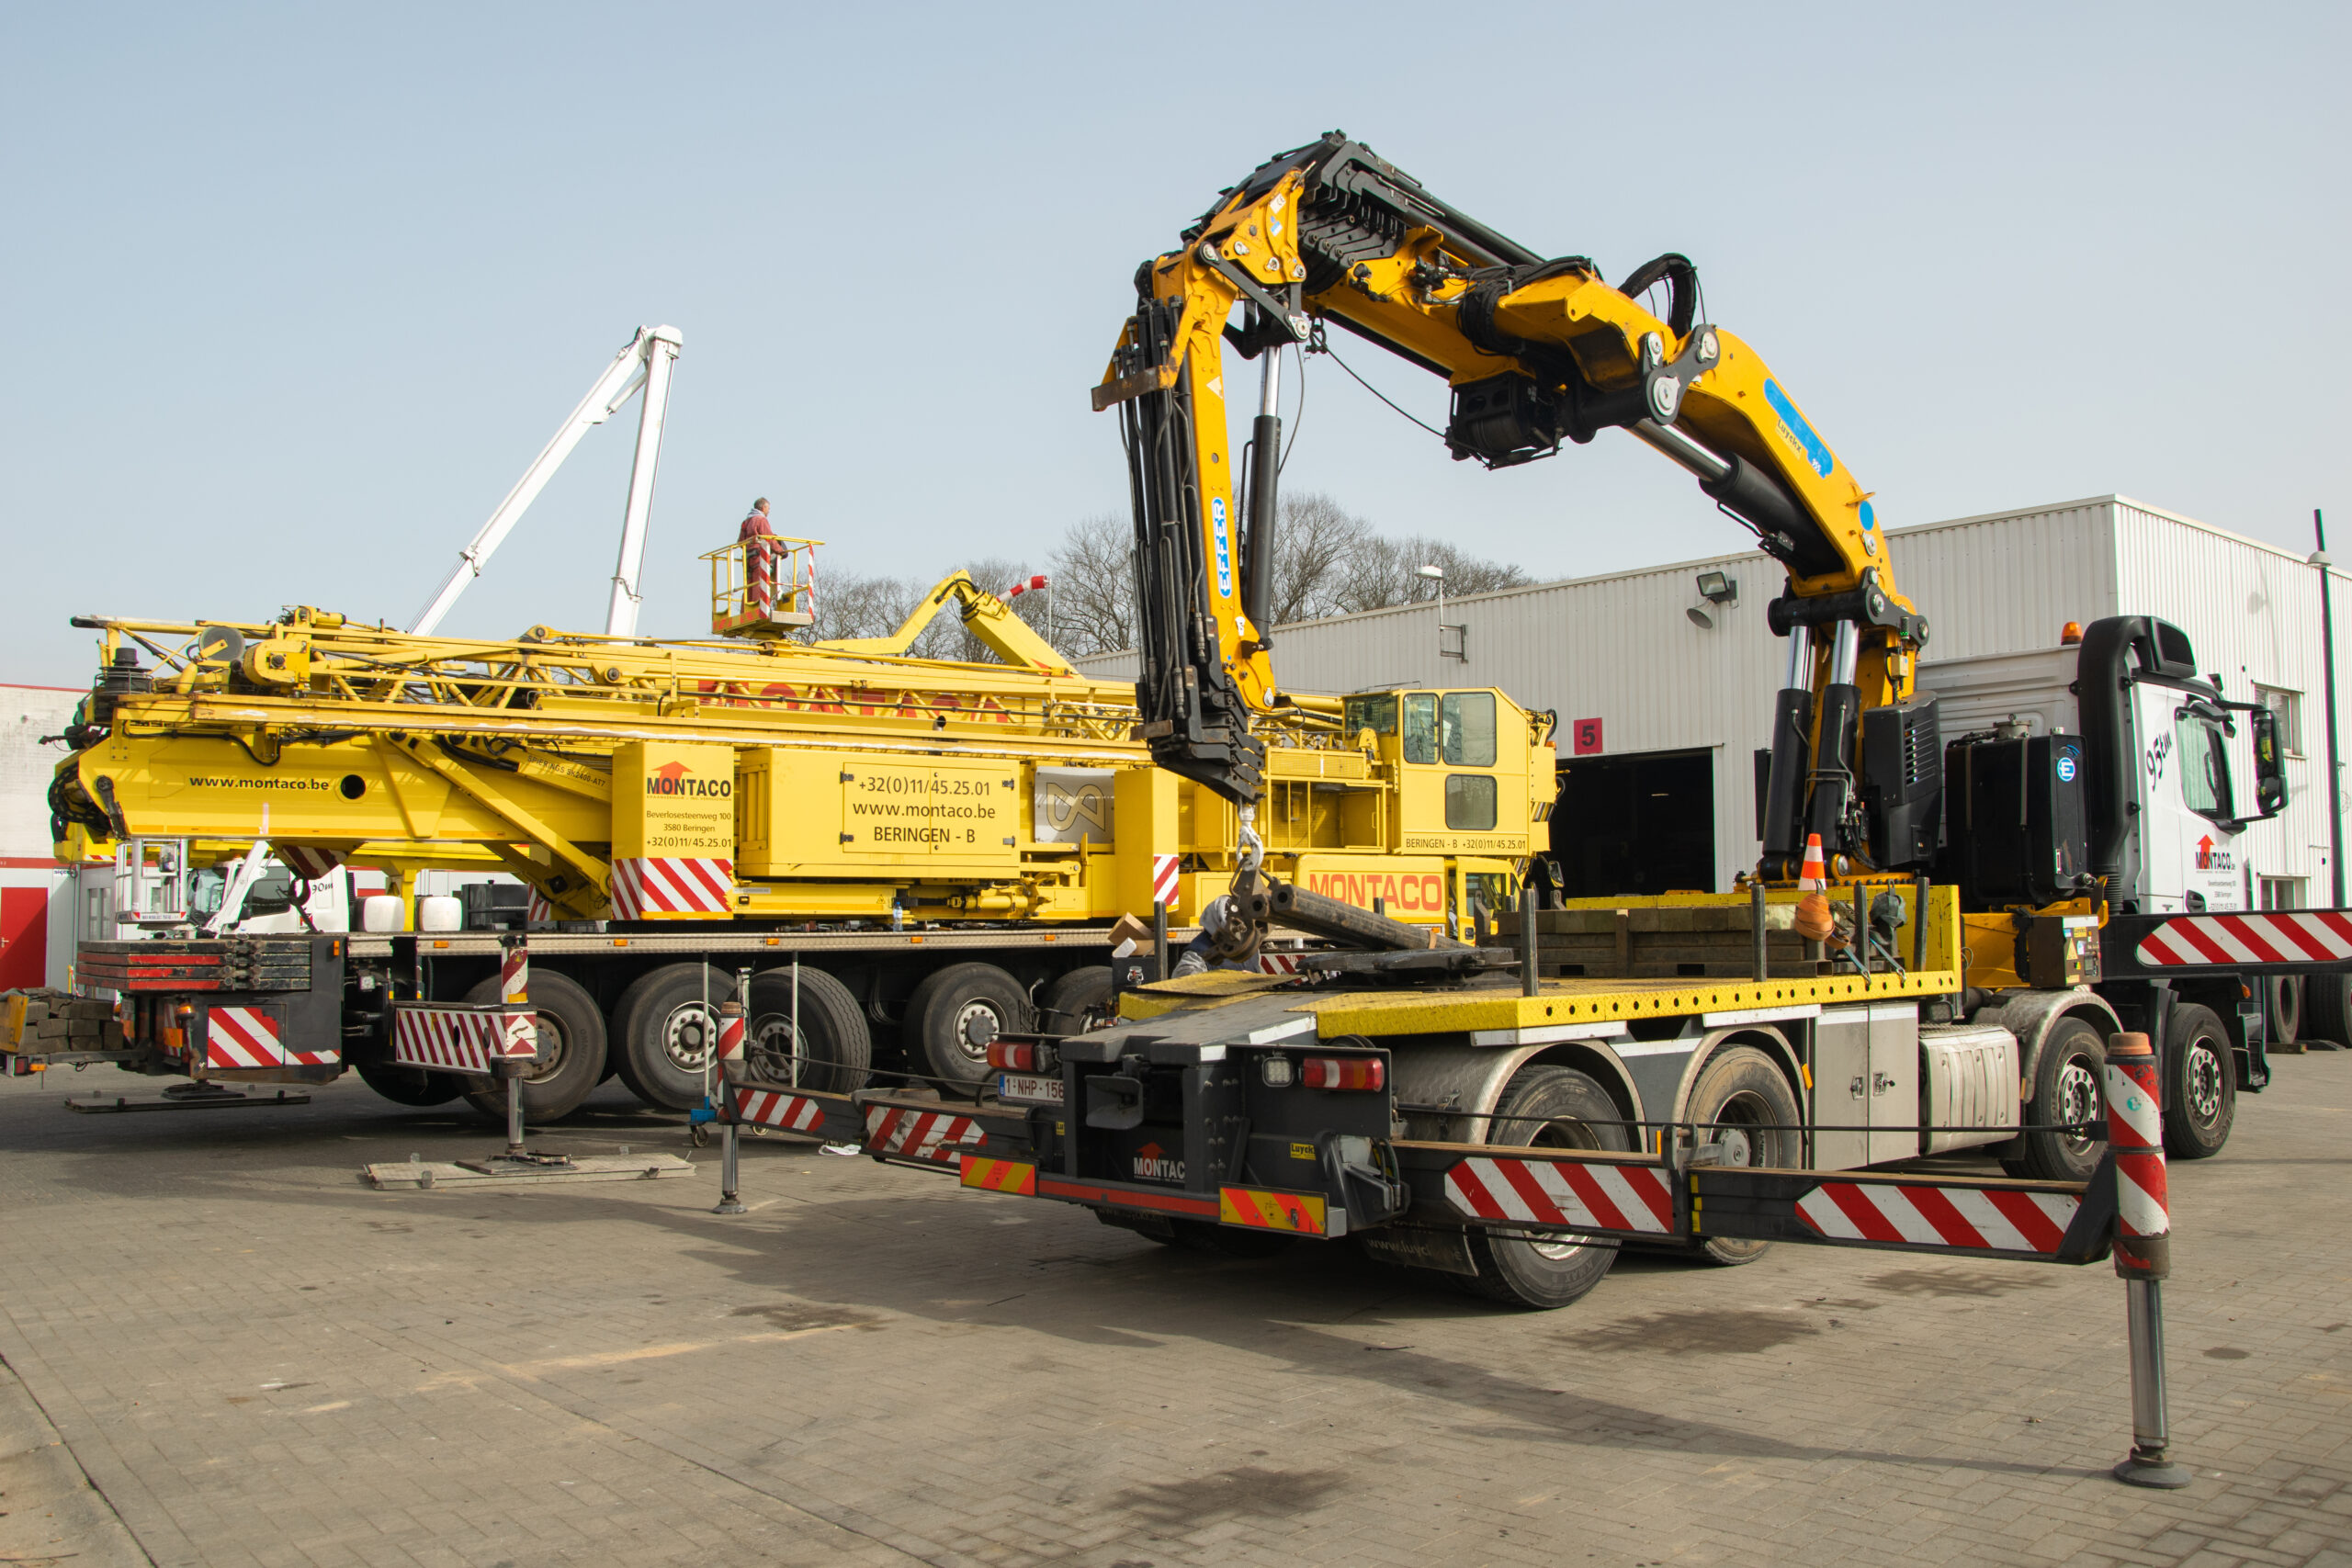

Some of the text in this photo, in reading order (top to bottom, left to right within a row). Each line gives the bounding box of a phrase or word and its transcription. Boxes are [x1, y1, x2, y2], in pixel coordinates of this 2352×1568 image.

[1213, 501, 1231, 592] EFFER
[1581, 725, 1596, 747] 5
[527, 755, 565, 773] SPIERINGS
[189, 777, 330, 791] www.montaco.be
[647, 777, 731, 797] MONTACO
[859, 776, 990, 796] +32(0)11/45.25.01
[646, 810, 732, 822] Beverlosesteenweg 100
[853, 803, 996, 819] www.montaco.be
[663, 823, 716, 833] 3580 Beringen
[874, 827, 950, 843] BERINGEN
[967, 829, 976, 843] B
[647, 836, 732, 848] +32(0)11/45.25.01
[1406, 838, 1445, 849] BERINGEN
[1453, 839, 1458, 849] B
[1462, 839, 1526, 850] +32(0)11/45.25.01
[1309, 874, 1442, 911] MONTACO
[1291, 1144, 1315, 1155] Luyck
[1134, 1157, 1185, 1179] MONTAC
